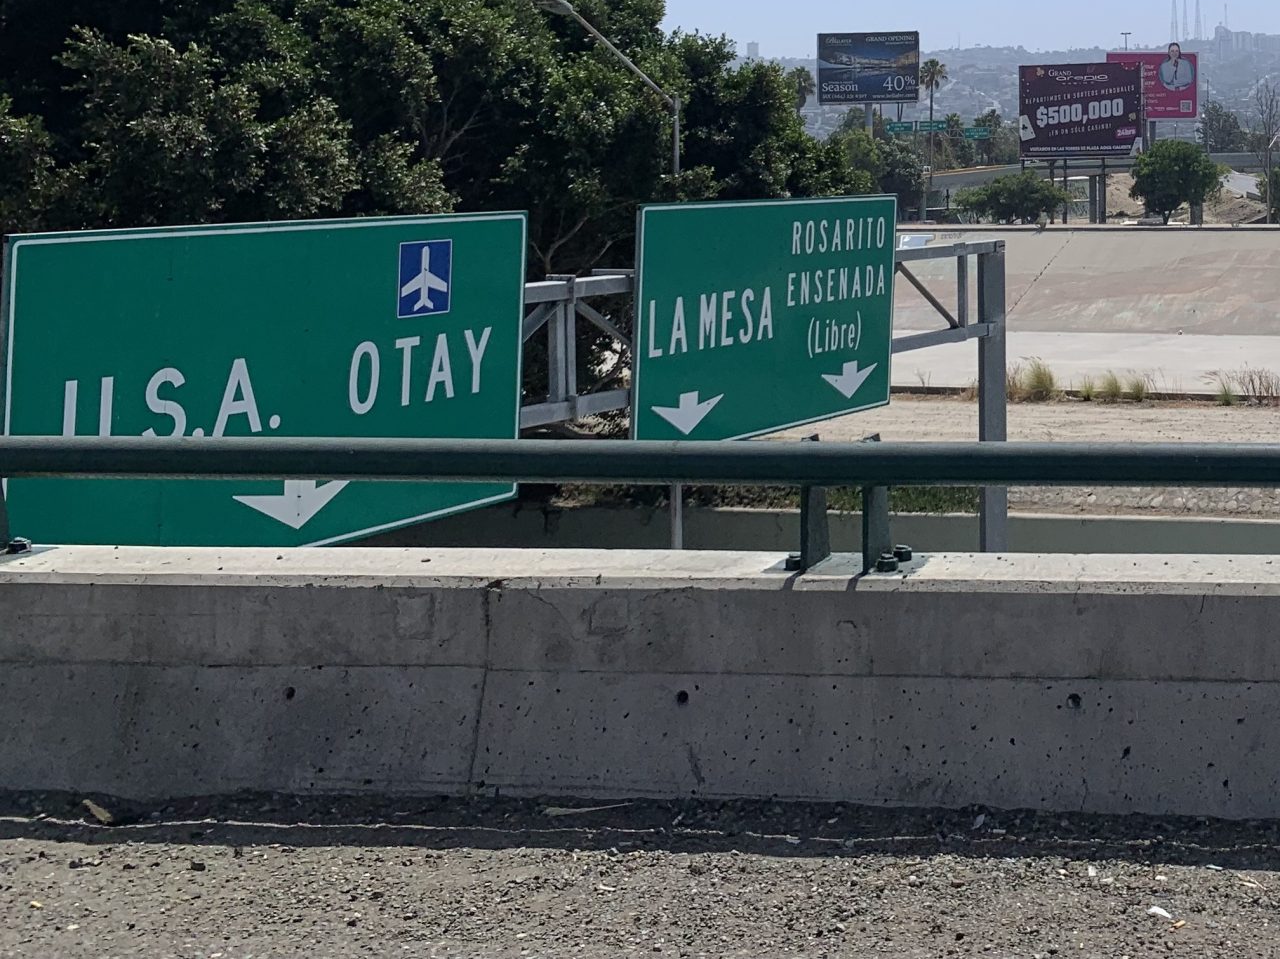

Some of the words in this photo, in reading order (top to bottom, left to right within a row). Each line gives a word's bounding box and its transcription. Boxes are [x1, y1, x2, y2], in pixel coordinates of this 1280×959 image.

[822, 83, 859, 92] Season
[883, 75, 915, 91] 40%
[1048, 69, 1072, 77] GRAND
[1036, 98, 1124, 128] $500,000
[791, 216, 886, 256] ROSARITO
[786, 263, 886, 308] ENSENADA
[647, 296, 688, 359] LA
[698, 285, 774, 351] MESA
[807, 311, 862, 359] (Libre)
[347, 326, 493, 416] OTAY
[62, 357, 282, 438] US.A.
